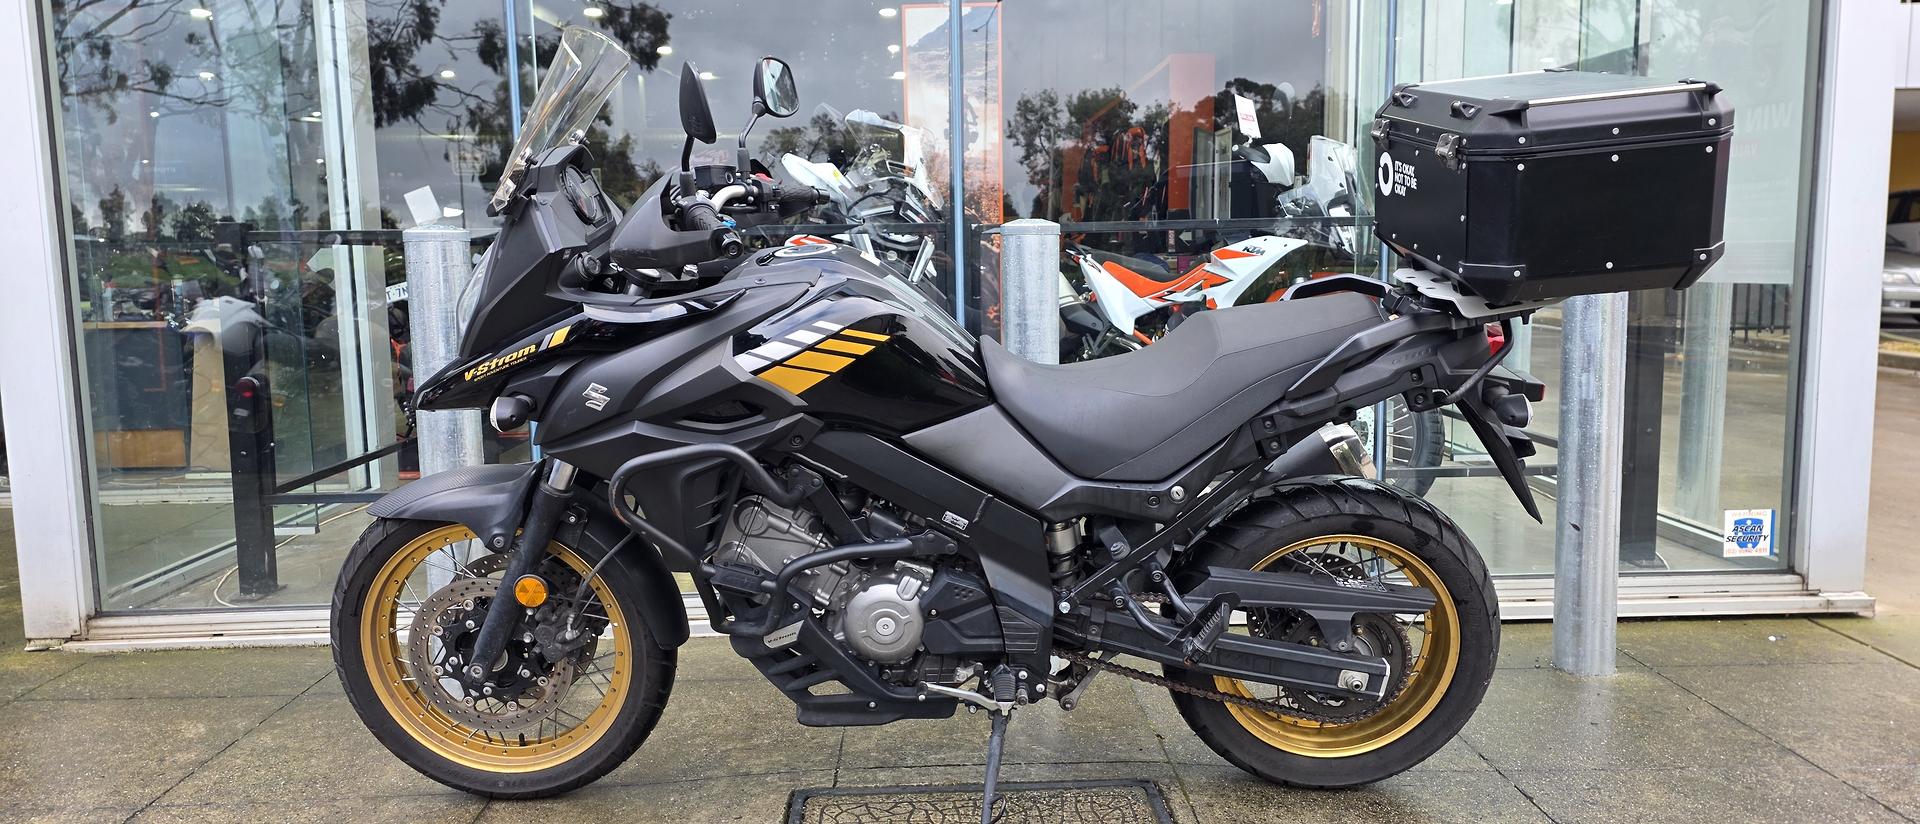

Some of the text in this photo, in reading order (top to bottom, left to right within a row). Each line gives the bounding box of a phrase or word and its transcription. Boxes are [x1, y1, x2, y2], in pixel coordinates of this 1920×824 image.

[1394, 172, 1417, 189] NOT TO BE
[1394, 183, 1406, 196] OKAY
[1242, 245, 1266, 256] KTM
[1732, 525, 1764, 533] ASCAN
[1726, 535, 1769, 543] SECURITY
